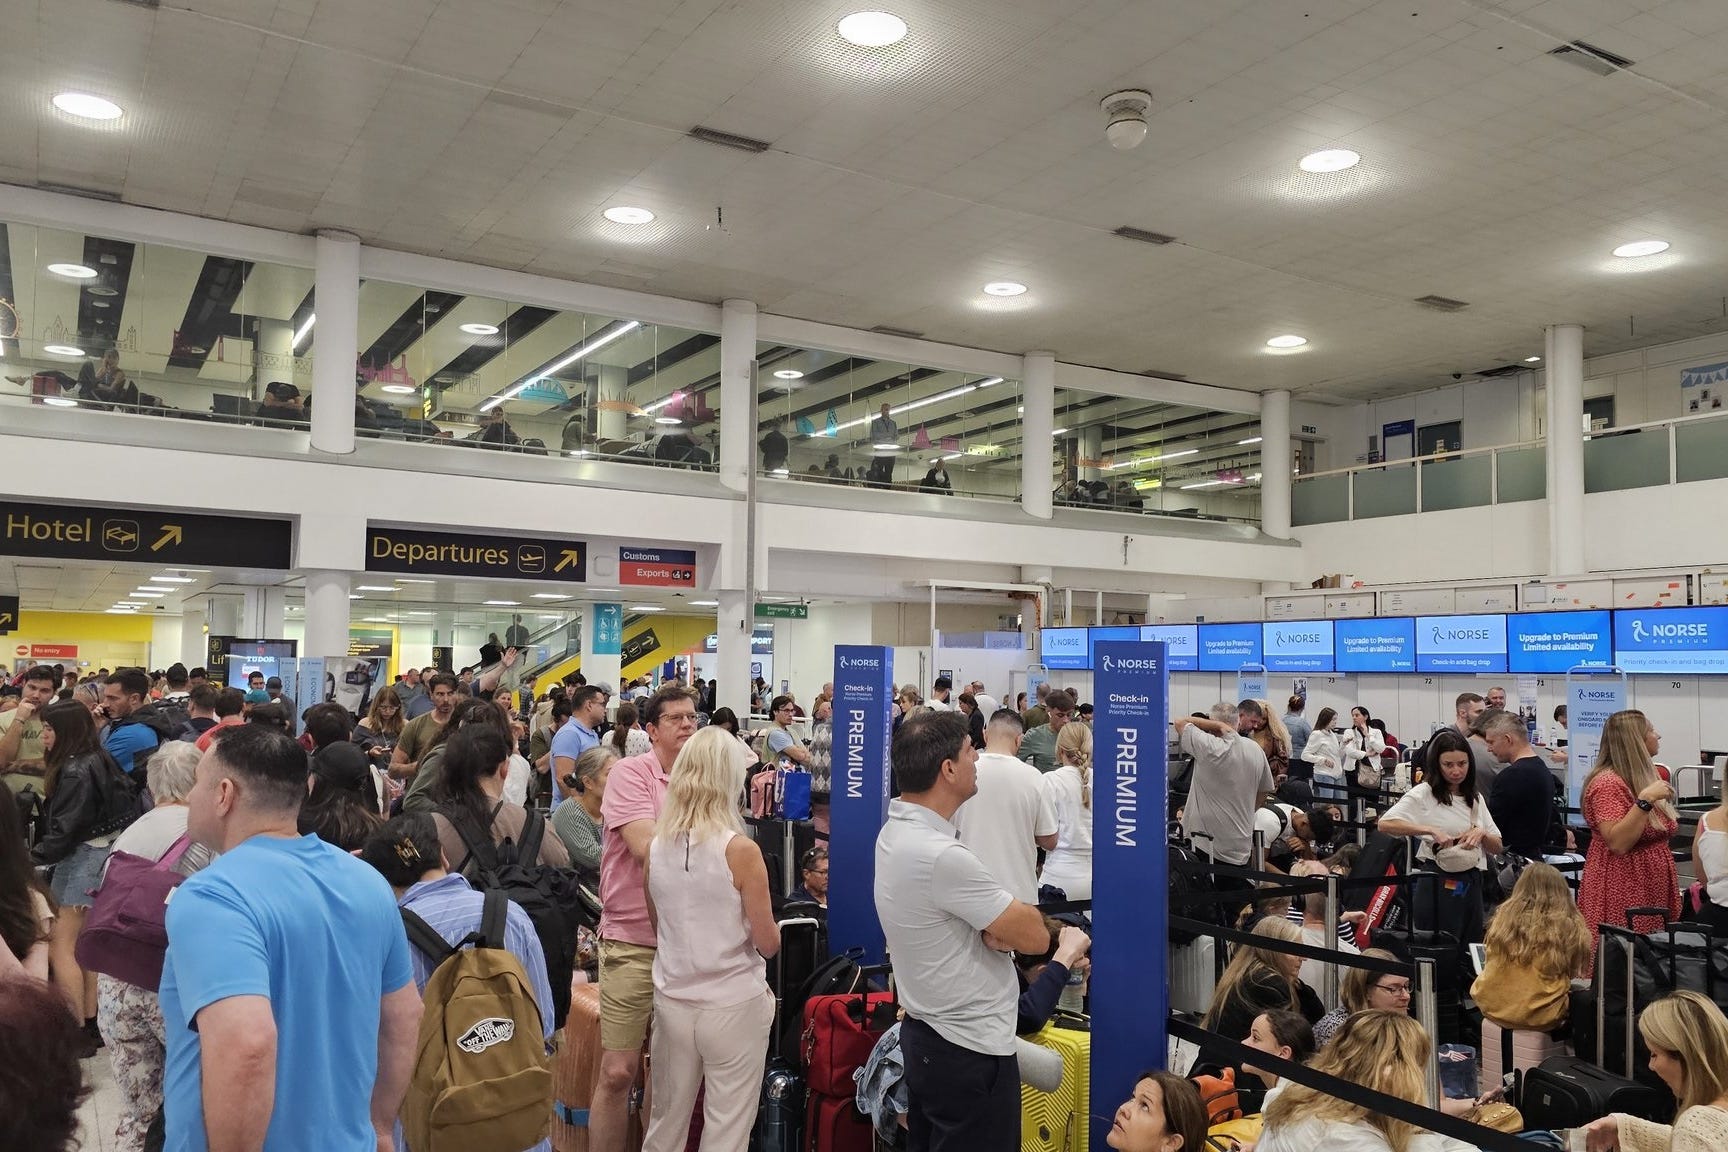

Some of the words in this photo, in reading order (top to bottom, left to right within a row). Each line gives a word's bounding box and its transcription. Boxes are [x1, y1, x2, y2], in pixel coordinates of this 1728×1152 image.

[6, 514, 91, 542] Hotel
[372, 536, 510, 565] Departures
[623, 552, 660, 561] Customs
[636, 568, 670, 578] Exports
[1448, 630, 1489, 640] NORSE
[1653, 624, 1708, 636] NORSE
[1288, 634, 1320, 643] NORSE
[1519, 633, 1552, 643] Upgrade
[1563, 632, 1598, 640] Premium
[1370, 646, 1402, 654] availability
[1552, 642, 1594, 652] availability
[1118, 659, 1157, 669] NORSE
[1110, 694, 1149, 702] Check-in
[847, 709, 864, 798] PREMIUM
[1115, 727, 1137, 847] PREMIUM
[474, 1021, 495, 1037] VANS
[481, 1029, 498, 1043] THE
